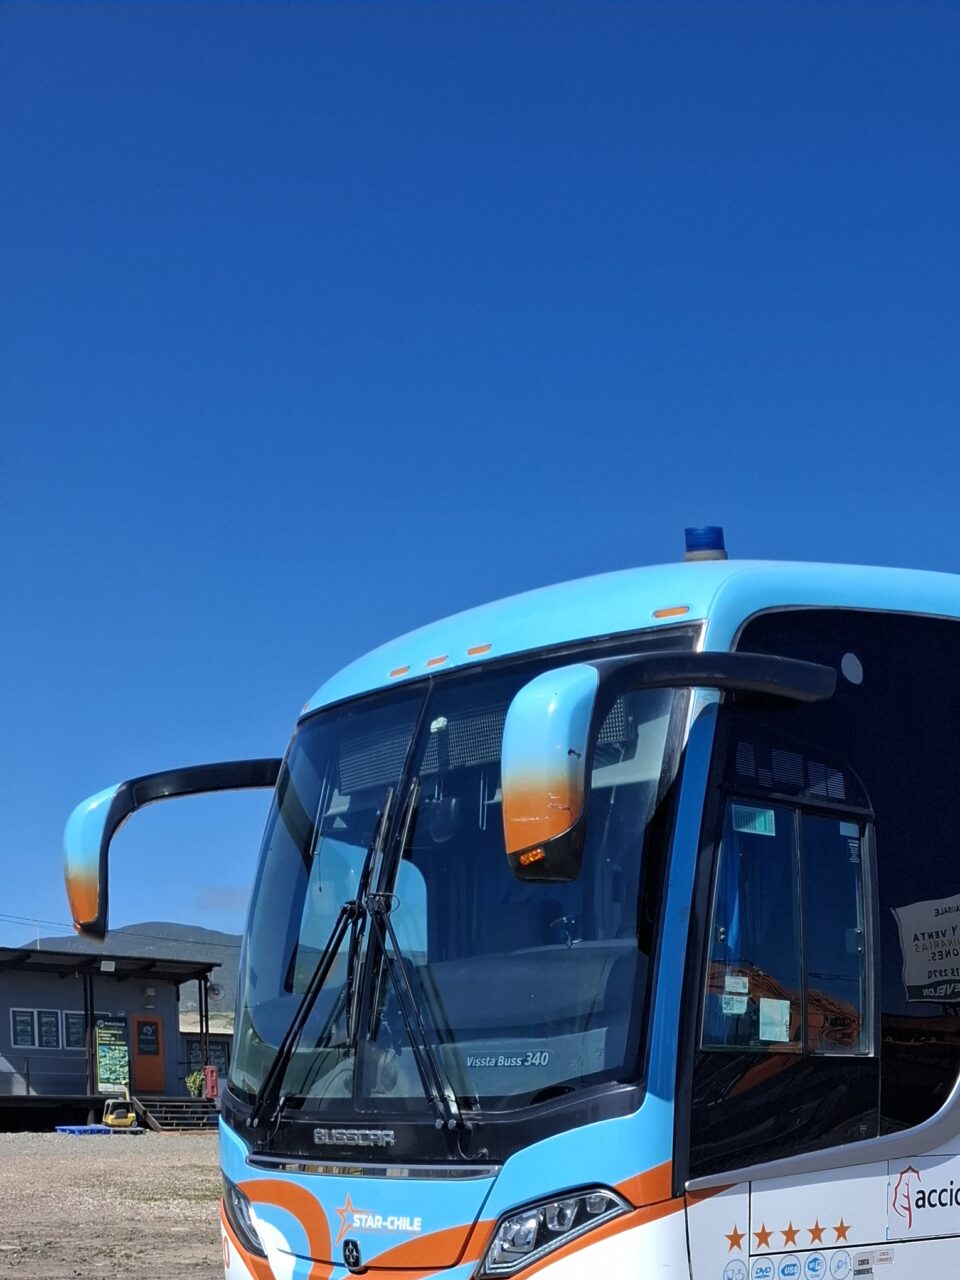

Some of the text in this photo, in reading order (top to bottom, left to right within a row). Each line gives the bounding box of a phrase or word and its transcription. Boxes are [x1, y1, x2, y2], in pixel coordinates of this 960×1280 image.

[466, 1051, 549, 1068] Vissta Buss 340
[313, 1128, 395, 1147] BUSSCAR
[353, 1214, 422, 1231] STAR-CHILE
[755, 1267, 772, 1275] DVD
[784, 1265, 798, 1273] USB
